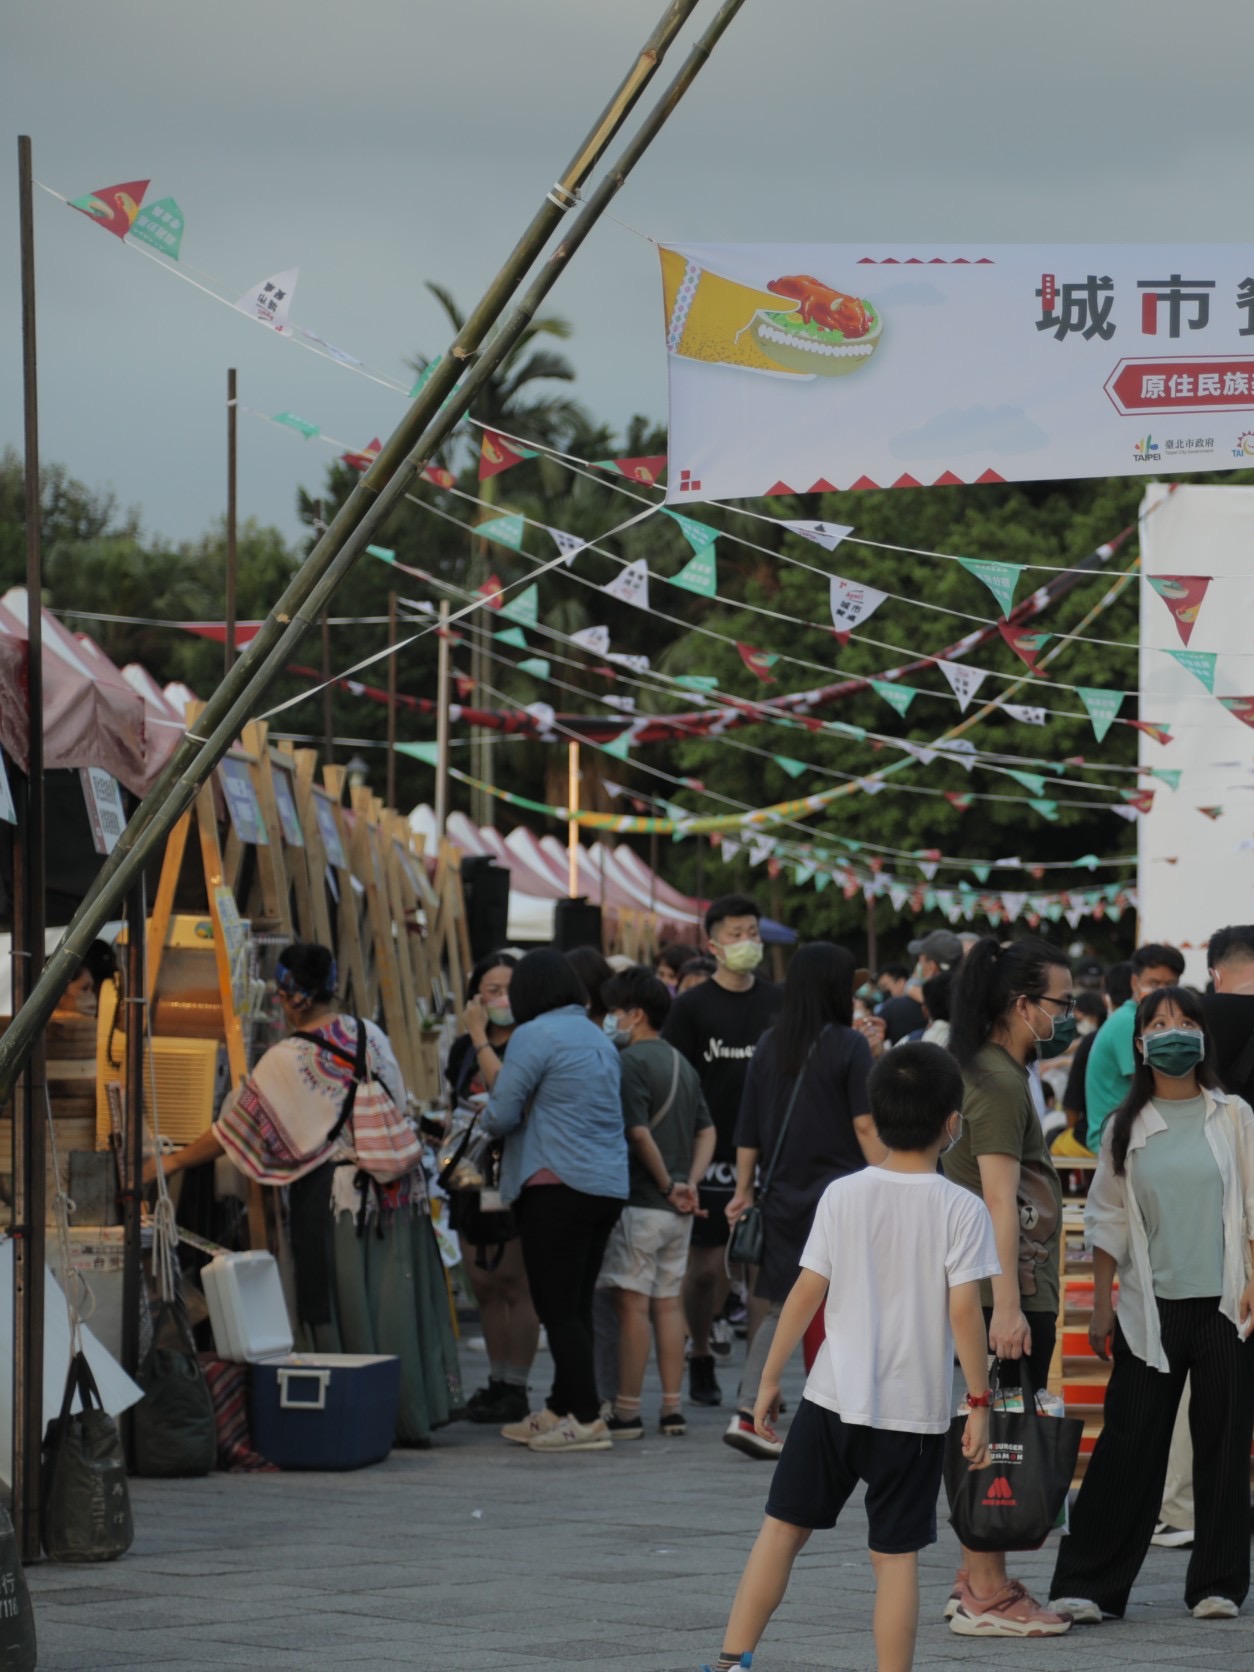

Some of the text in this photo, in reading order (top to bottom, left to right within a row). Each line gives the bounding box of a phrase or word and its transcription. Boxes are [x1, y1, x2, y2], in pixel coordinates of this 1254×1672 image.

[1164, 437, 1215, 449] 臺北市政府
[1133, 453, 1162, 462] TAIPEI
